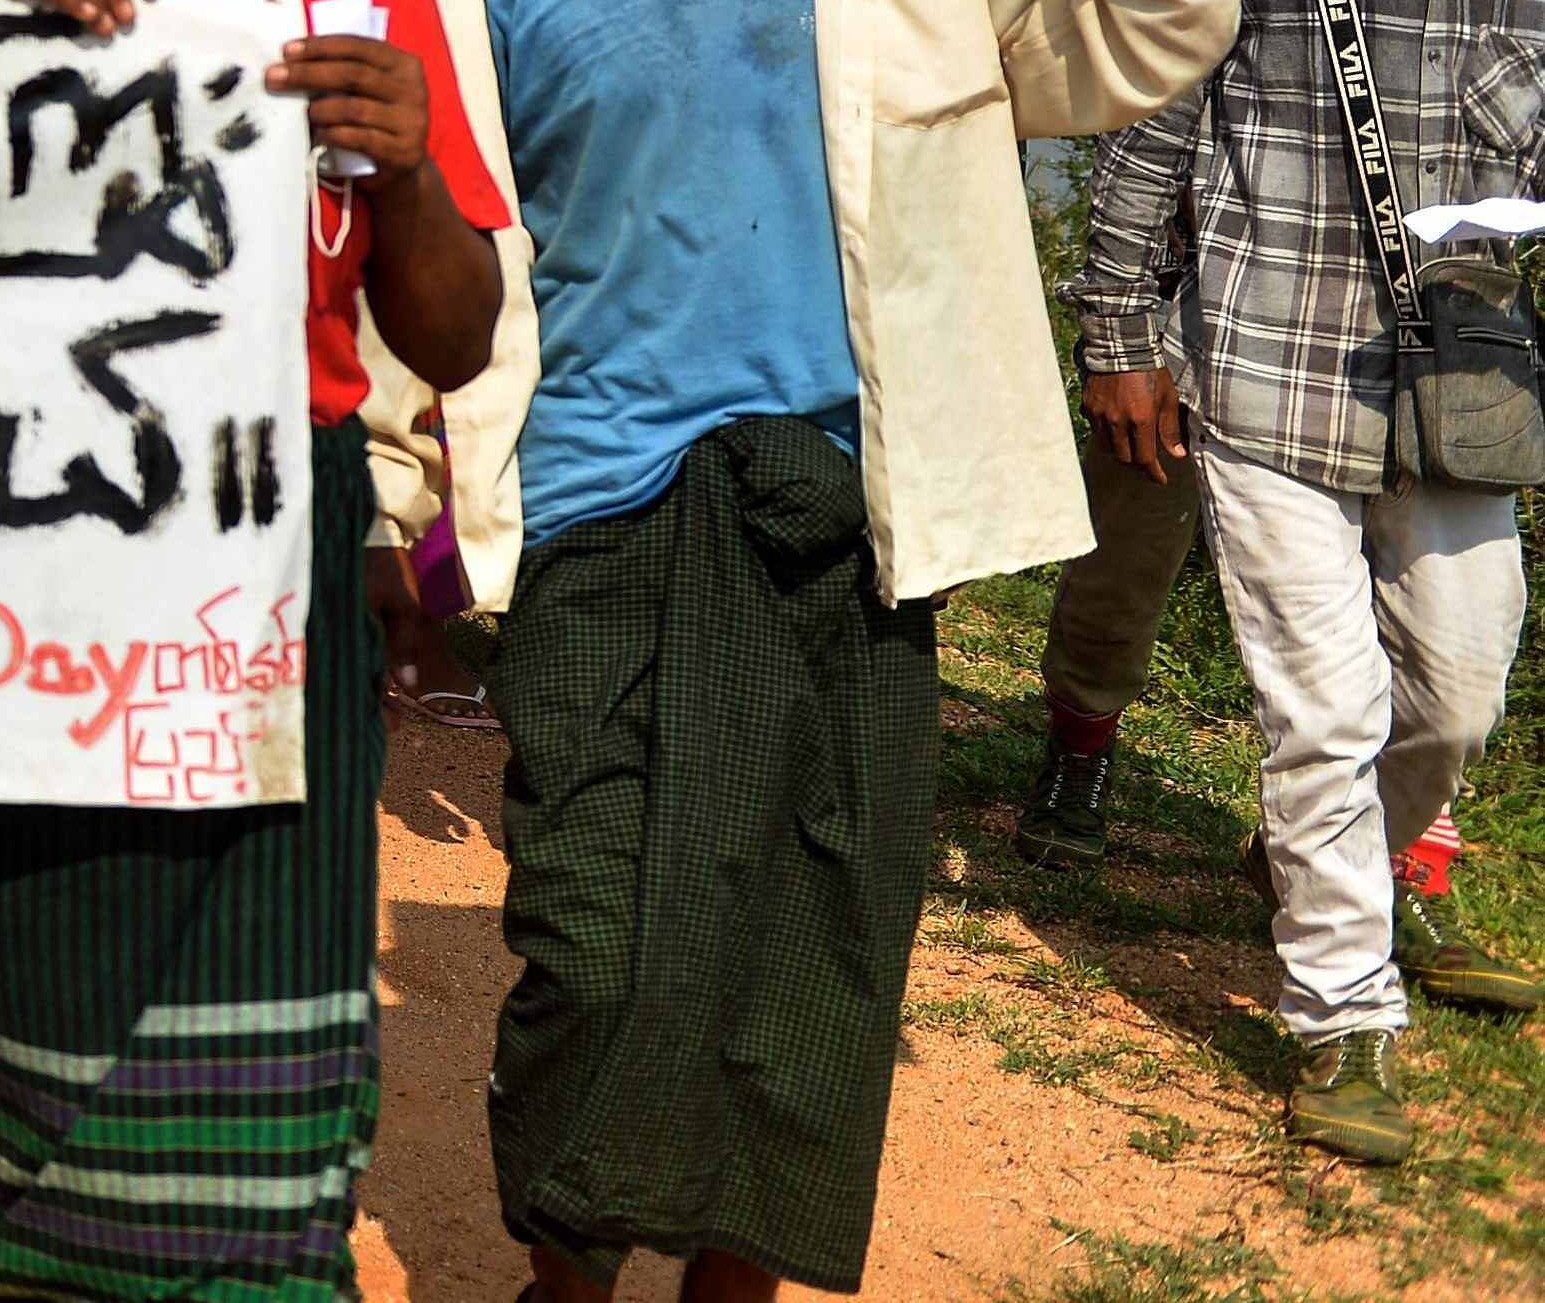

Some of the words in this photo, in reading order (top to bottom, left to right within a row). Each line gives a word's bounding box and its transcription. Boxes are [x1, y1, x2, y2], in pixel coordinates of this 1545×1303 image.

[1339, 41, 1368, 98] FILA
[1358, 117, 1385, 175] FILA
[1376, 195, 1401, 252] FILA
